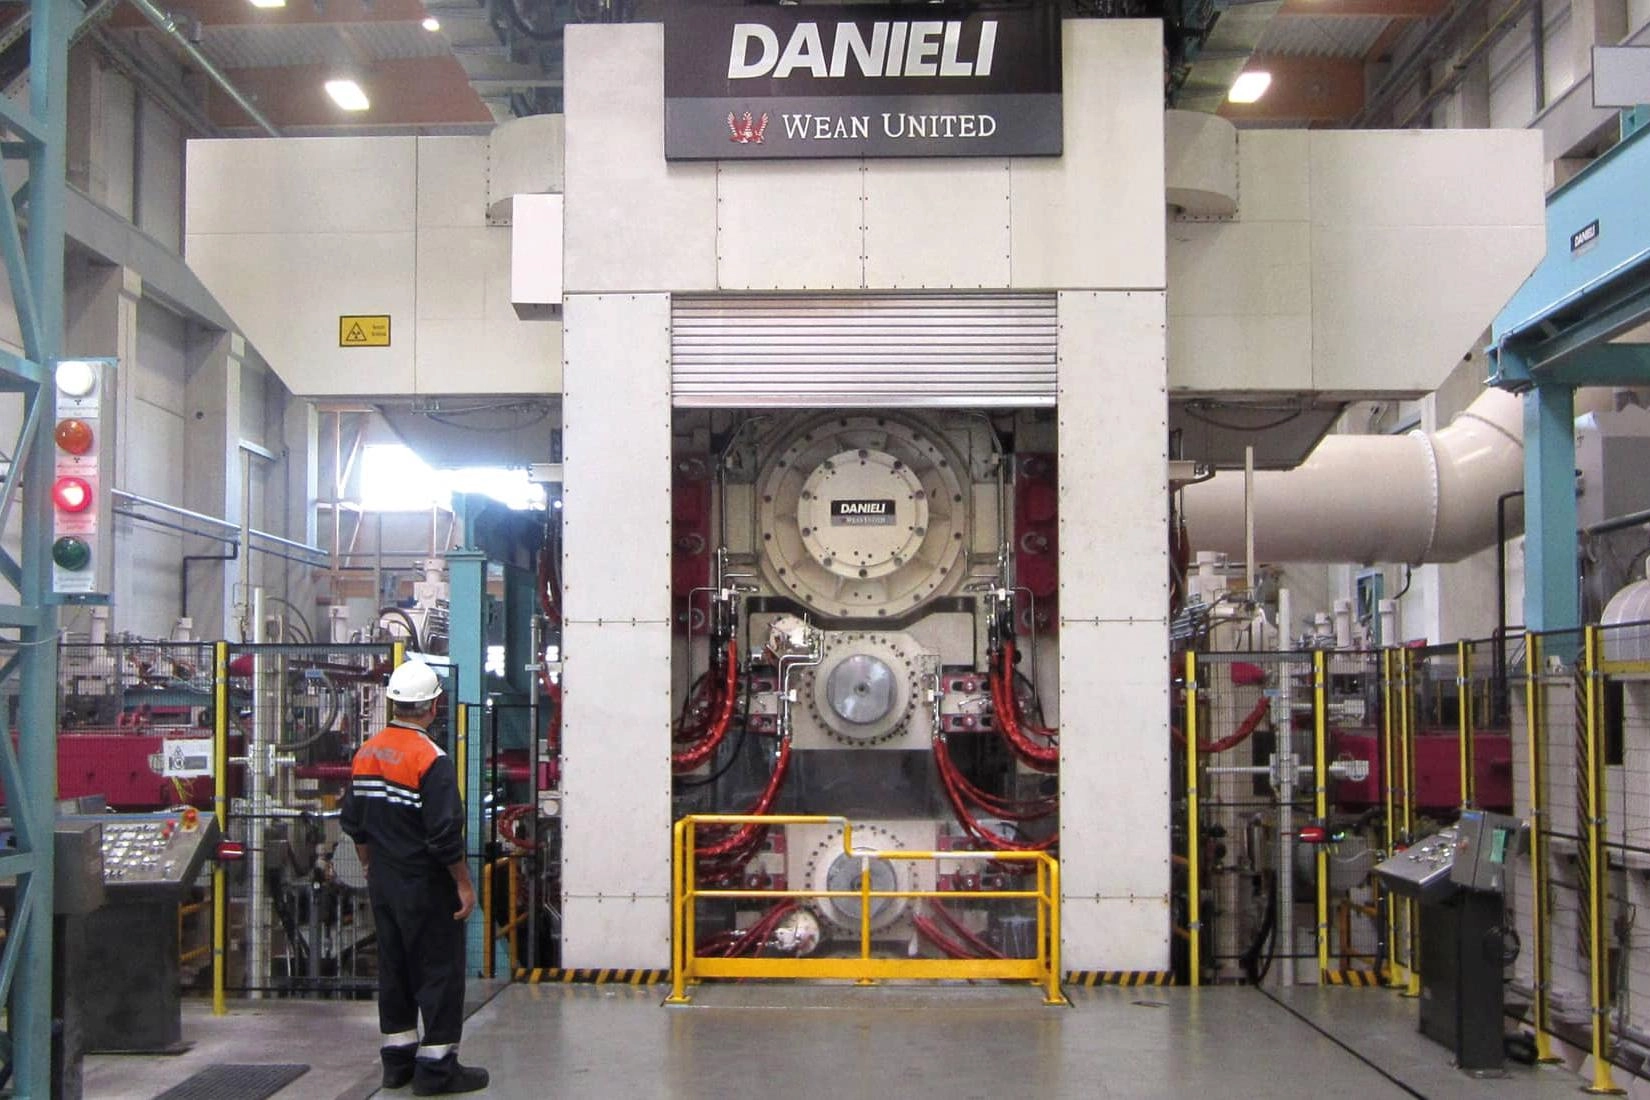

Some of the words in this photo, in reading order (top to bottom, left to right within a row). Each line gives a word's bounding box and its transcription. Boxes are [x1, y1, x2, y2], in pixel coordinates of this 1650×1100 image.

[728, 21, 998, 79] DANIELI
[782, 114, 869, 139] WEAN
[881, 113, 996, 138] UNITED
[841, 503, 886, 514] DANIELI
